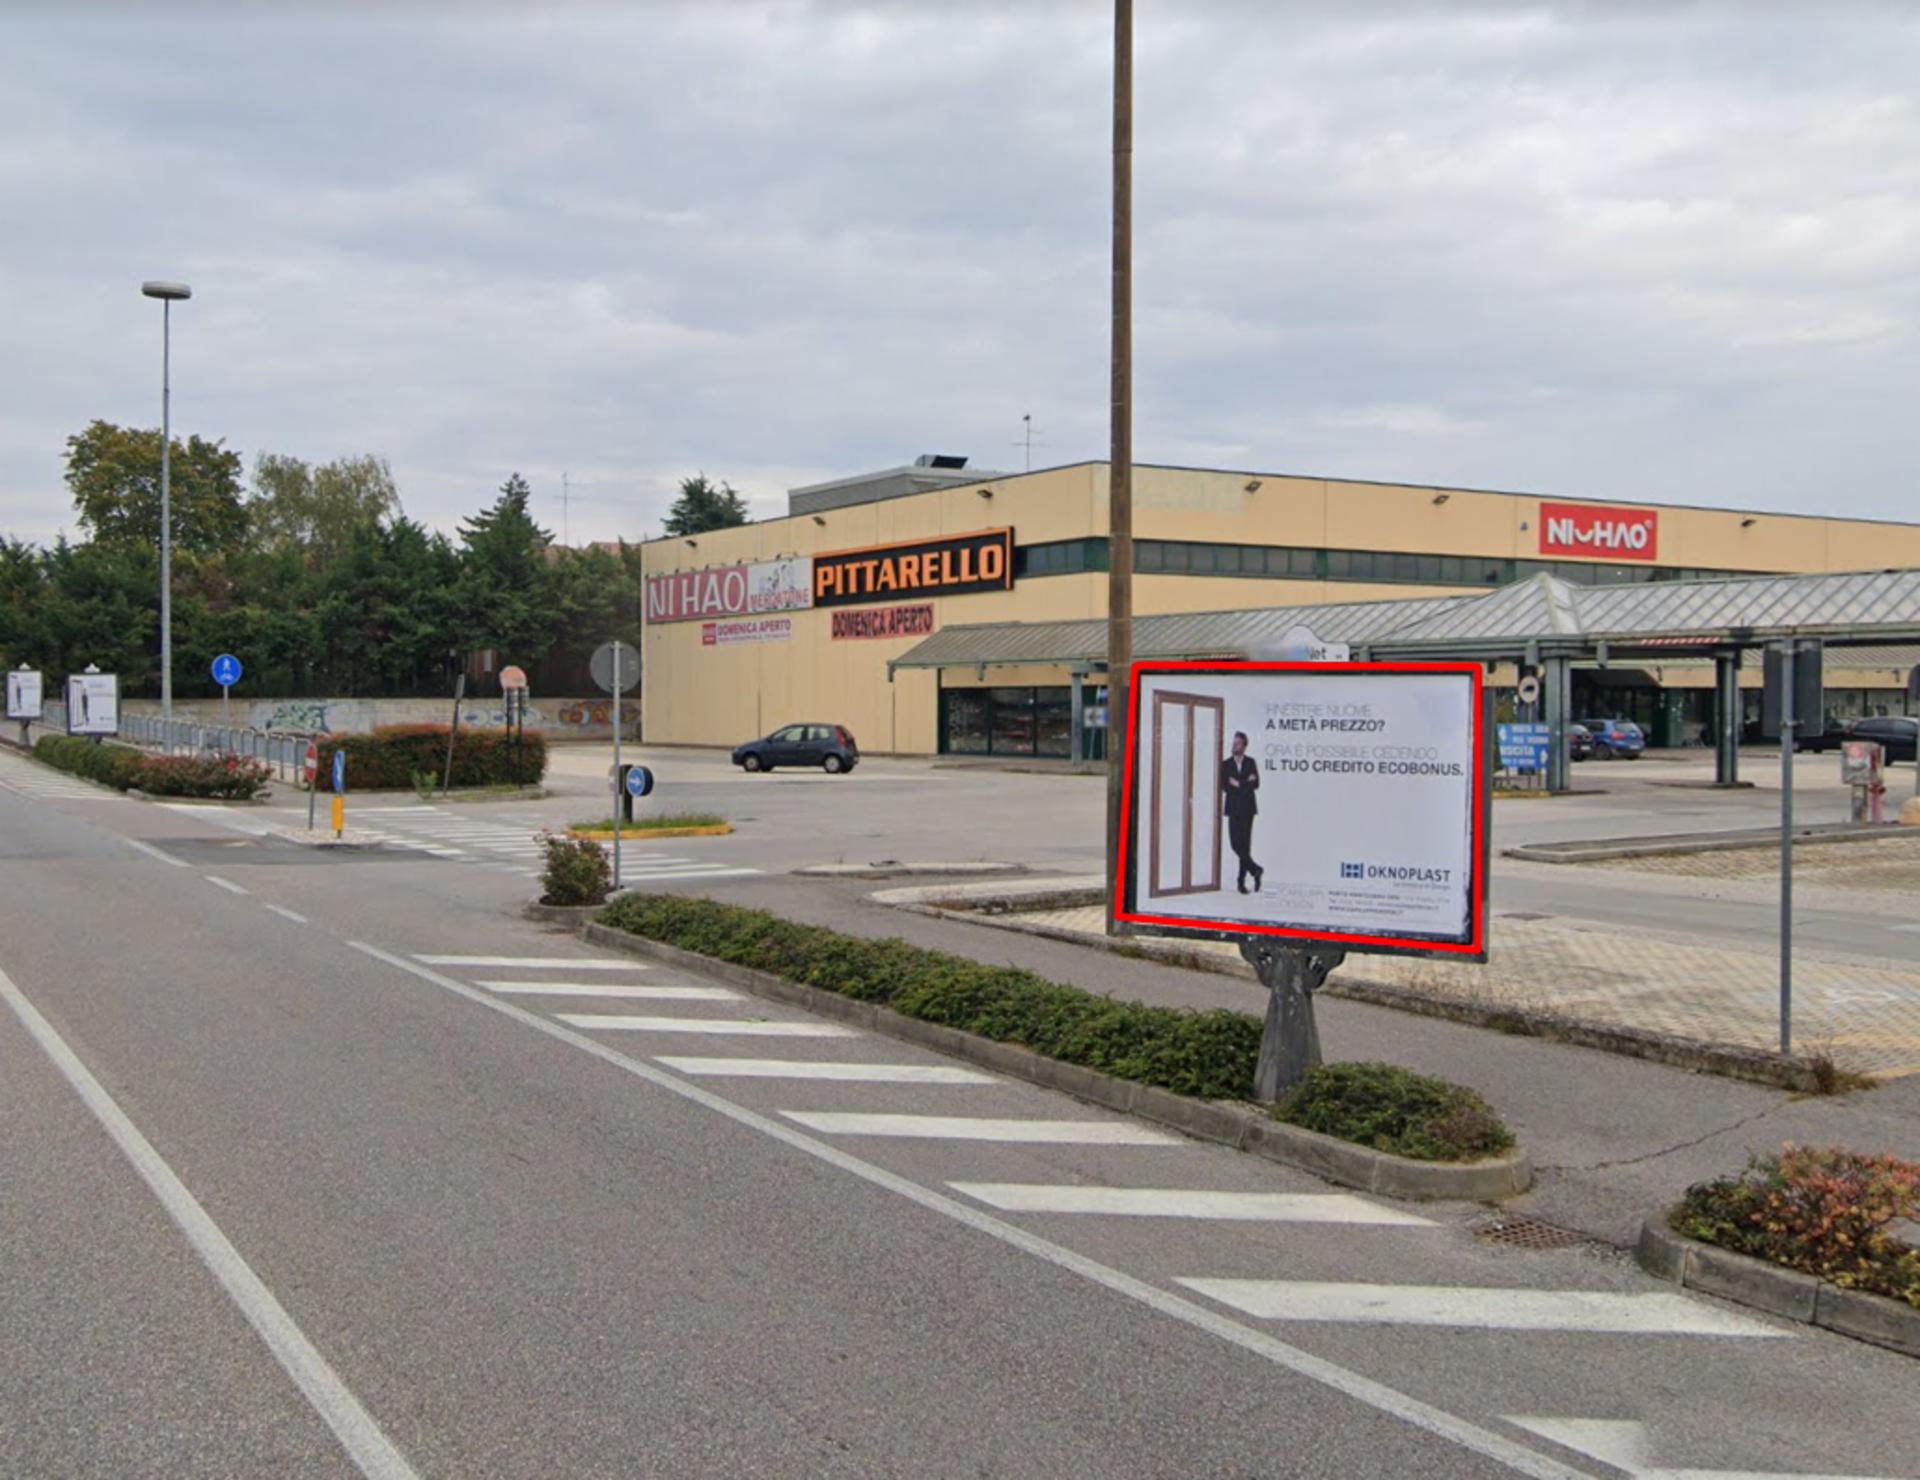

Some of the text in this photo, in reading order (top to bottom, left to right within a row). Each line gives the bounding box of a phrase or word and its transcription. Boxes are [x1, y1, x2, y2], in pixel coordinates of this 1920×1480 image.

[816, 543, 1003, 597] PITTARELLO
[650, 571, 745, 618] NI HAO
[717, 622, 757, 636] DOMENICA
[759, 618, 791, 632] APERTO
[832, 605, 933, 637] DOMENICA APERTO
[1326, 704, 1372, 717] NUOVE
[1265, 715, 1386, 732] A METÀ PREZZO?
[1264, 759, 1465, 777] IL TUO CREDITO ECOBONUS.
[1367, 864, 1451, 882] OKNOPLAST
